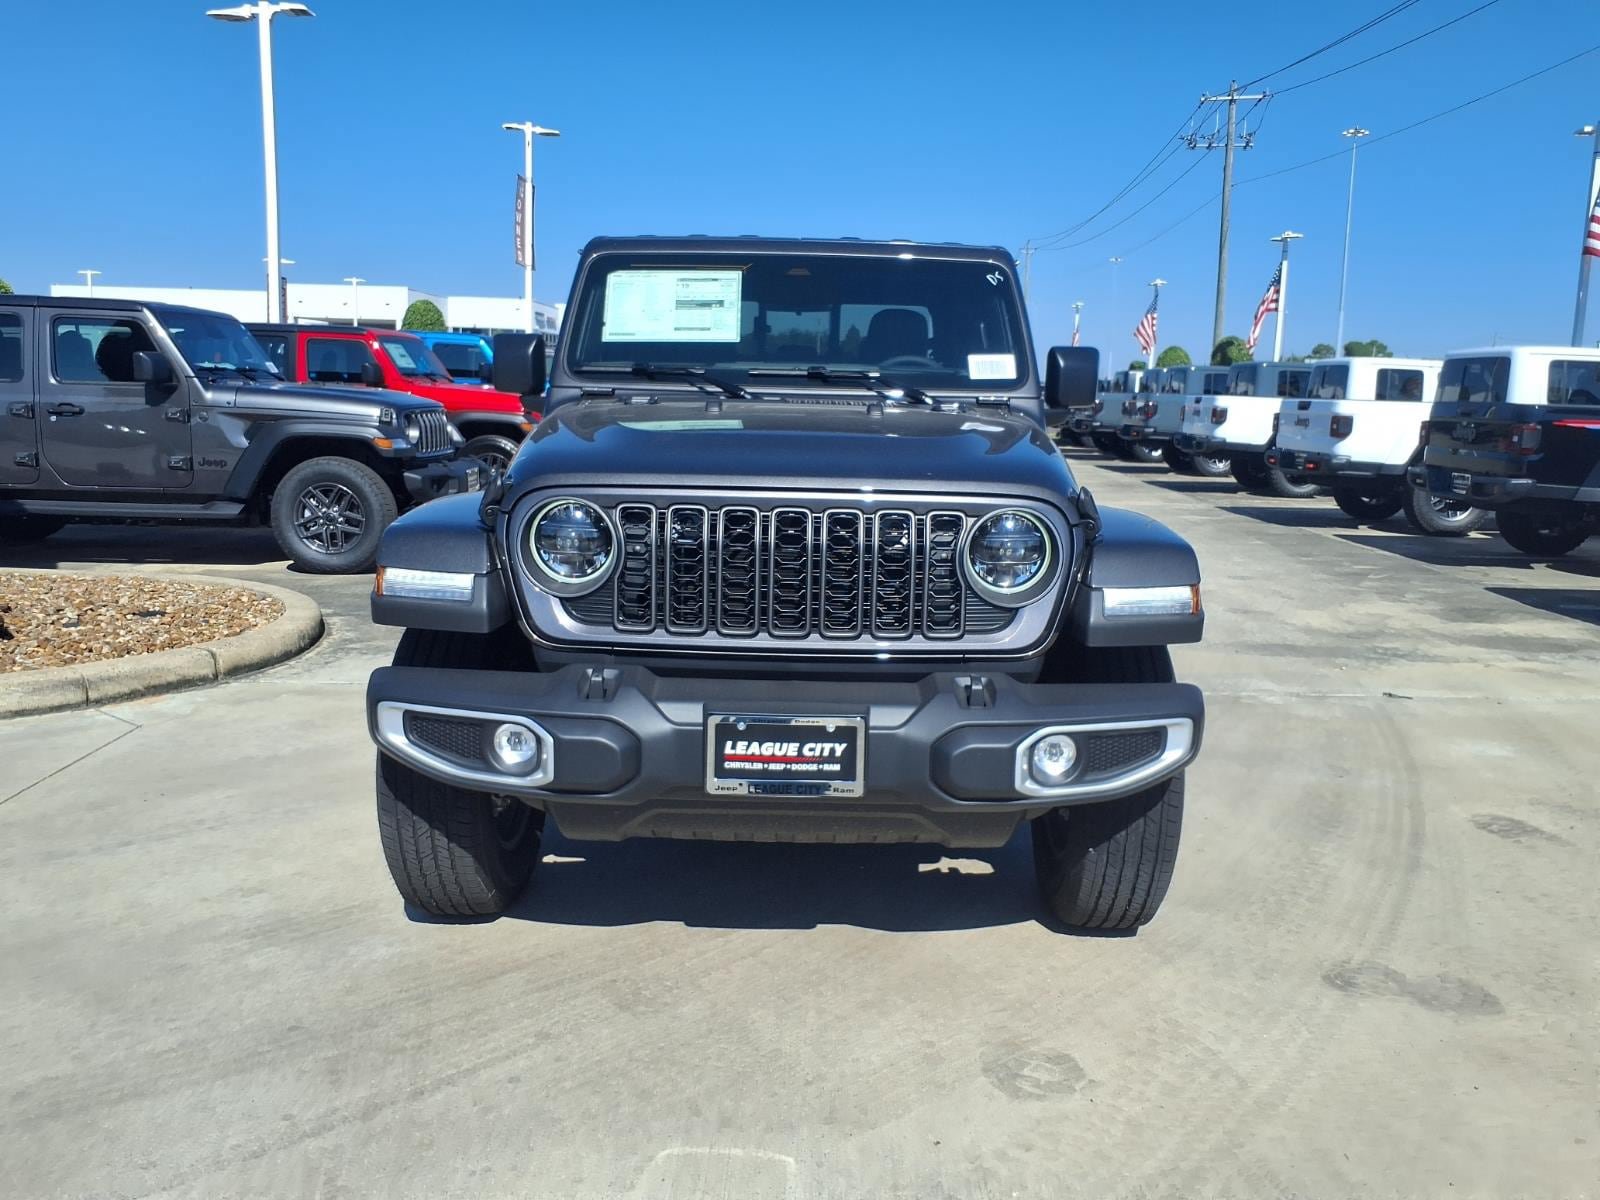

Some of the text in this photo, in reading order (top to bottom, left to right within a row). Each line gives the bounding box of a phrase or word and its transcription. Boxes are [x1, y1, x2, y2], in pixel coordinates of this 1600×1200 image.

[198, 457, 227, 468] Jeep
[724, 741, 848, 757] LEAGUE CITY
[724, 761, 763, 770] CHRYSLER
[791, 763, 819, 771] DODGE
[823, 763, 841, 771] RAM
[747, 783, 793, 794] LEAGUE
[796, 784, 820, 795] CITY
